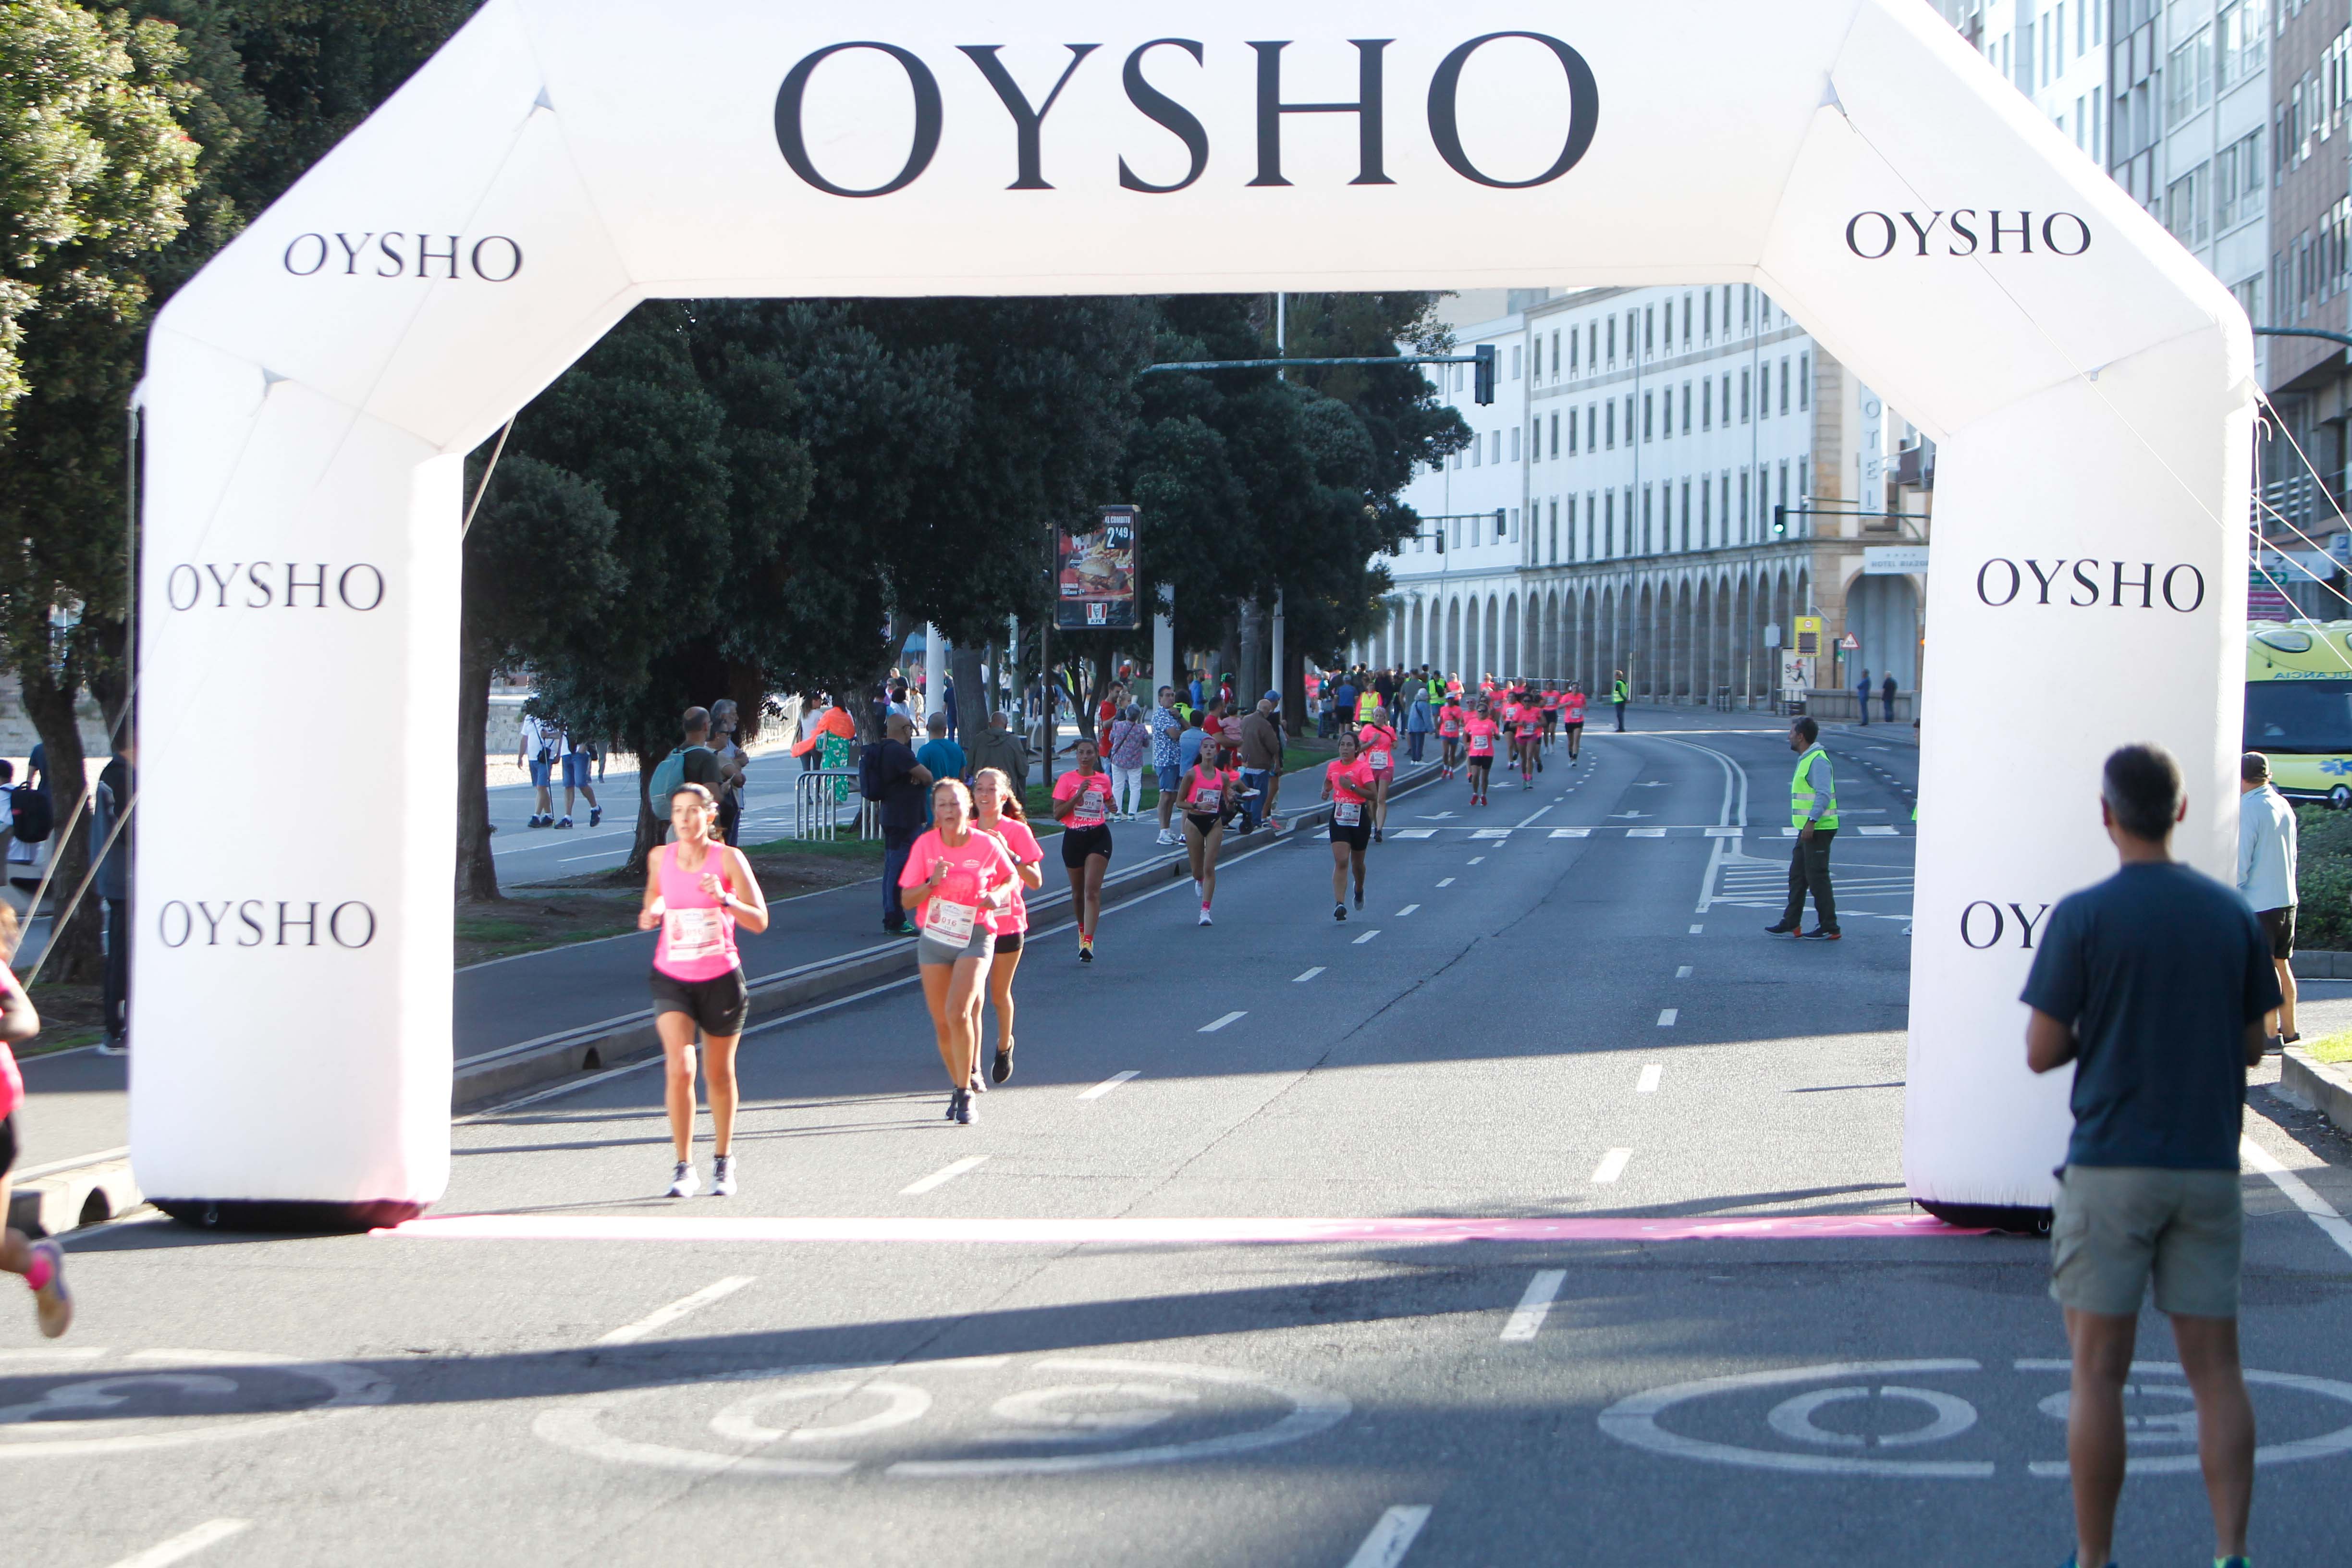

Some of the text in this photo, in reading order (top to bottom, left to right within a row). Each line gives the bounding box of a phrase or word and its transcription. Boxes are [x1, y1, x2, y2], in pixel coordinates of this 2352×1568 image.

[775, 32, 1599, 197] OYSHO
[283, 232, 523, 282] OYSHO
[1846, 210, 2090, 258] OYSHO
[1866, 399, 1882, 510] OTEL
[168, 562, 385, 611] OYSHO
[1977, 558, 2204, 612] OYSHO
[160, 900, 377, 948] OYSHO
[942, 917, 957, 926] 016
